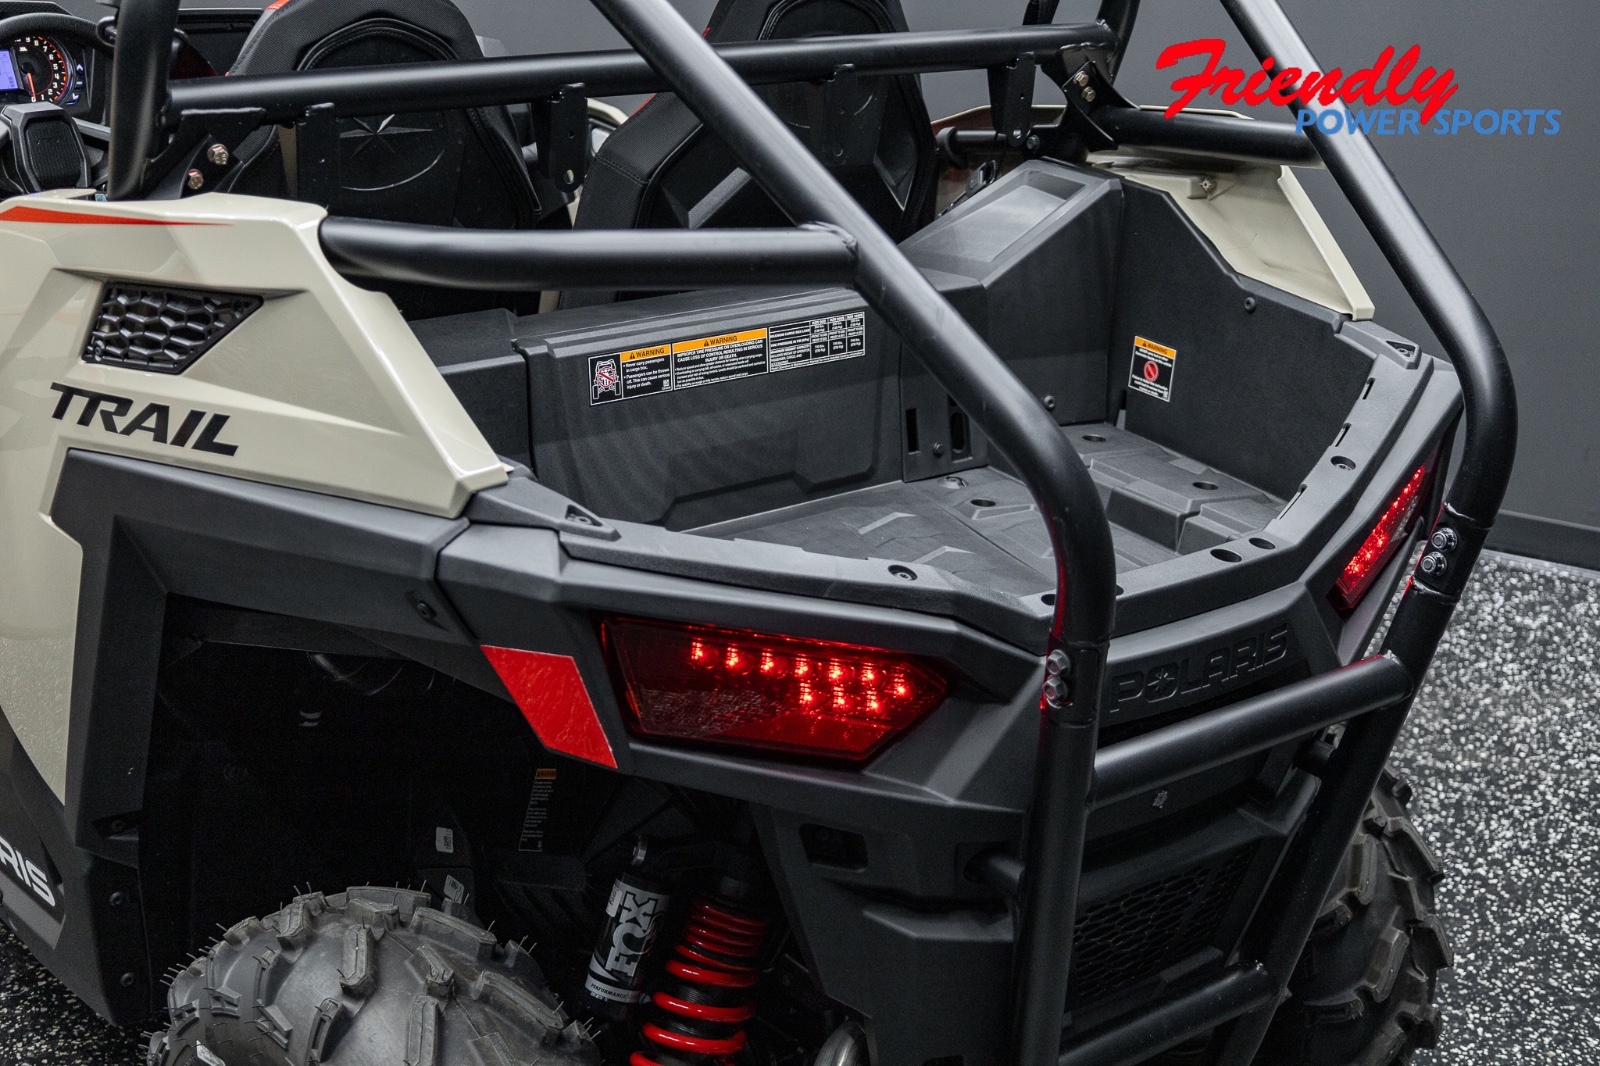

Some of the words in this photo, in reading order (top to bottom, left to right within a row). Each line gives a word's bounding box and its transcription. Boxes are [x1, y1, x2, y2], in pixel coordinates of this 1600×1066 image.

[50, 382, 239, 457] TRAIL
[1110, 624, 1288, 714] POLARIS
[604, 890, 660, 978] FOX
